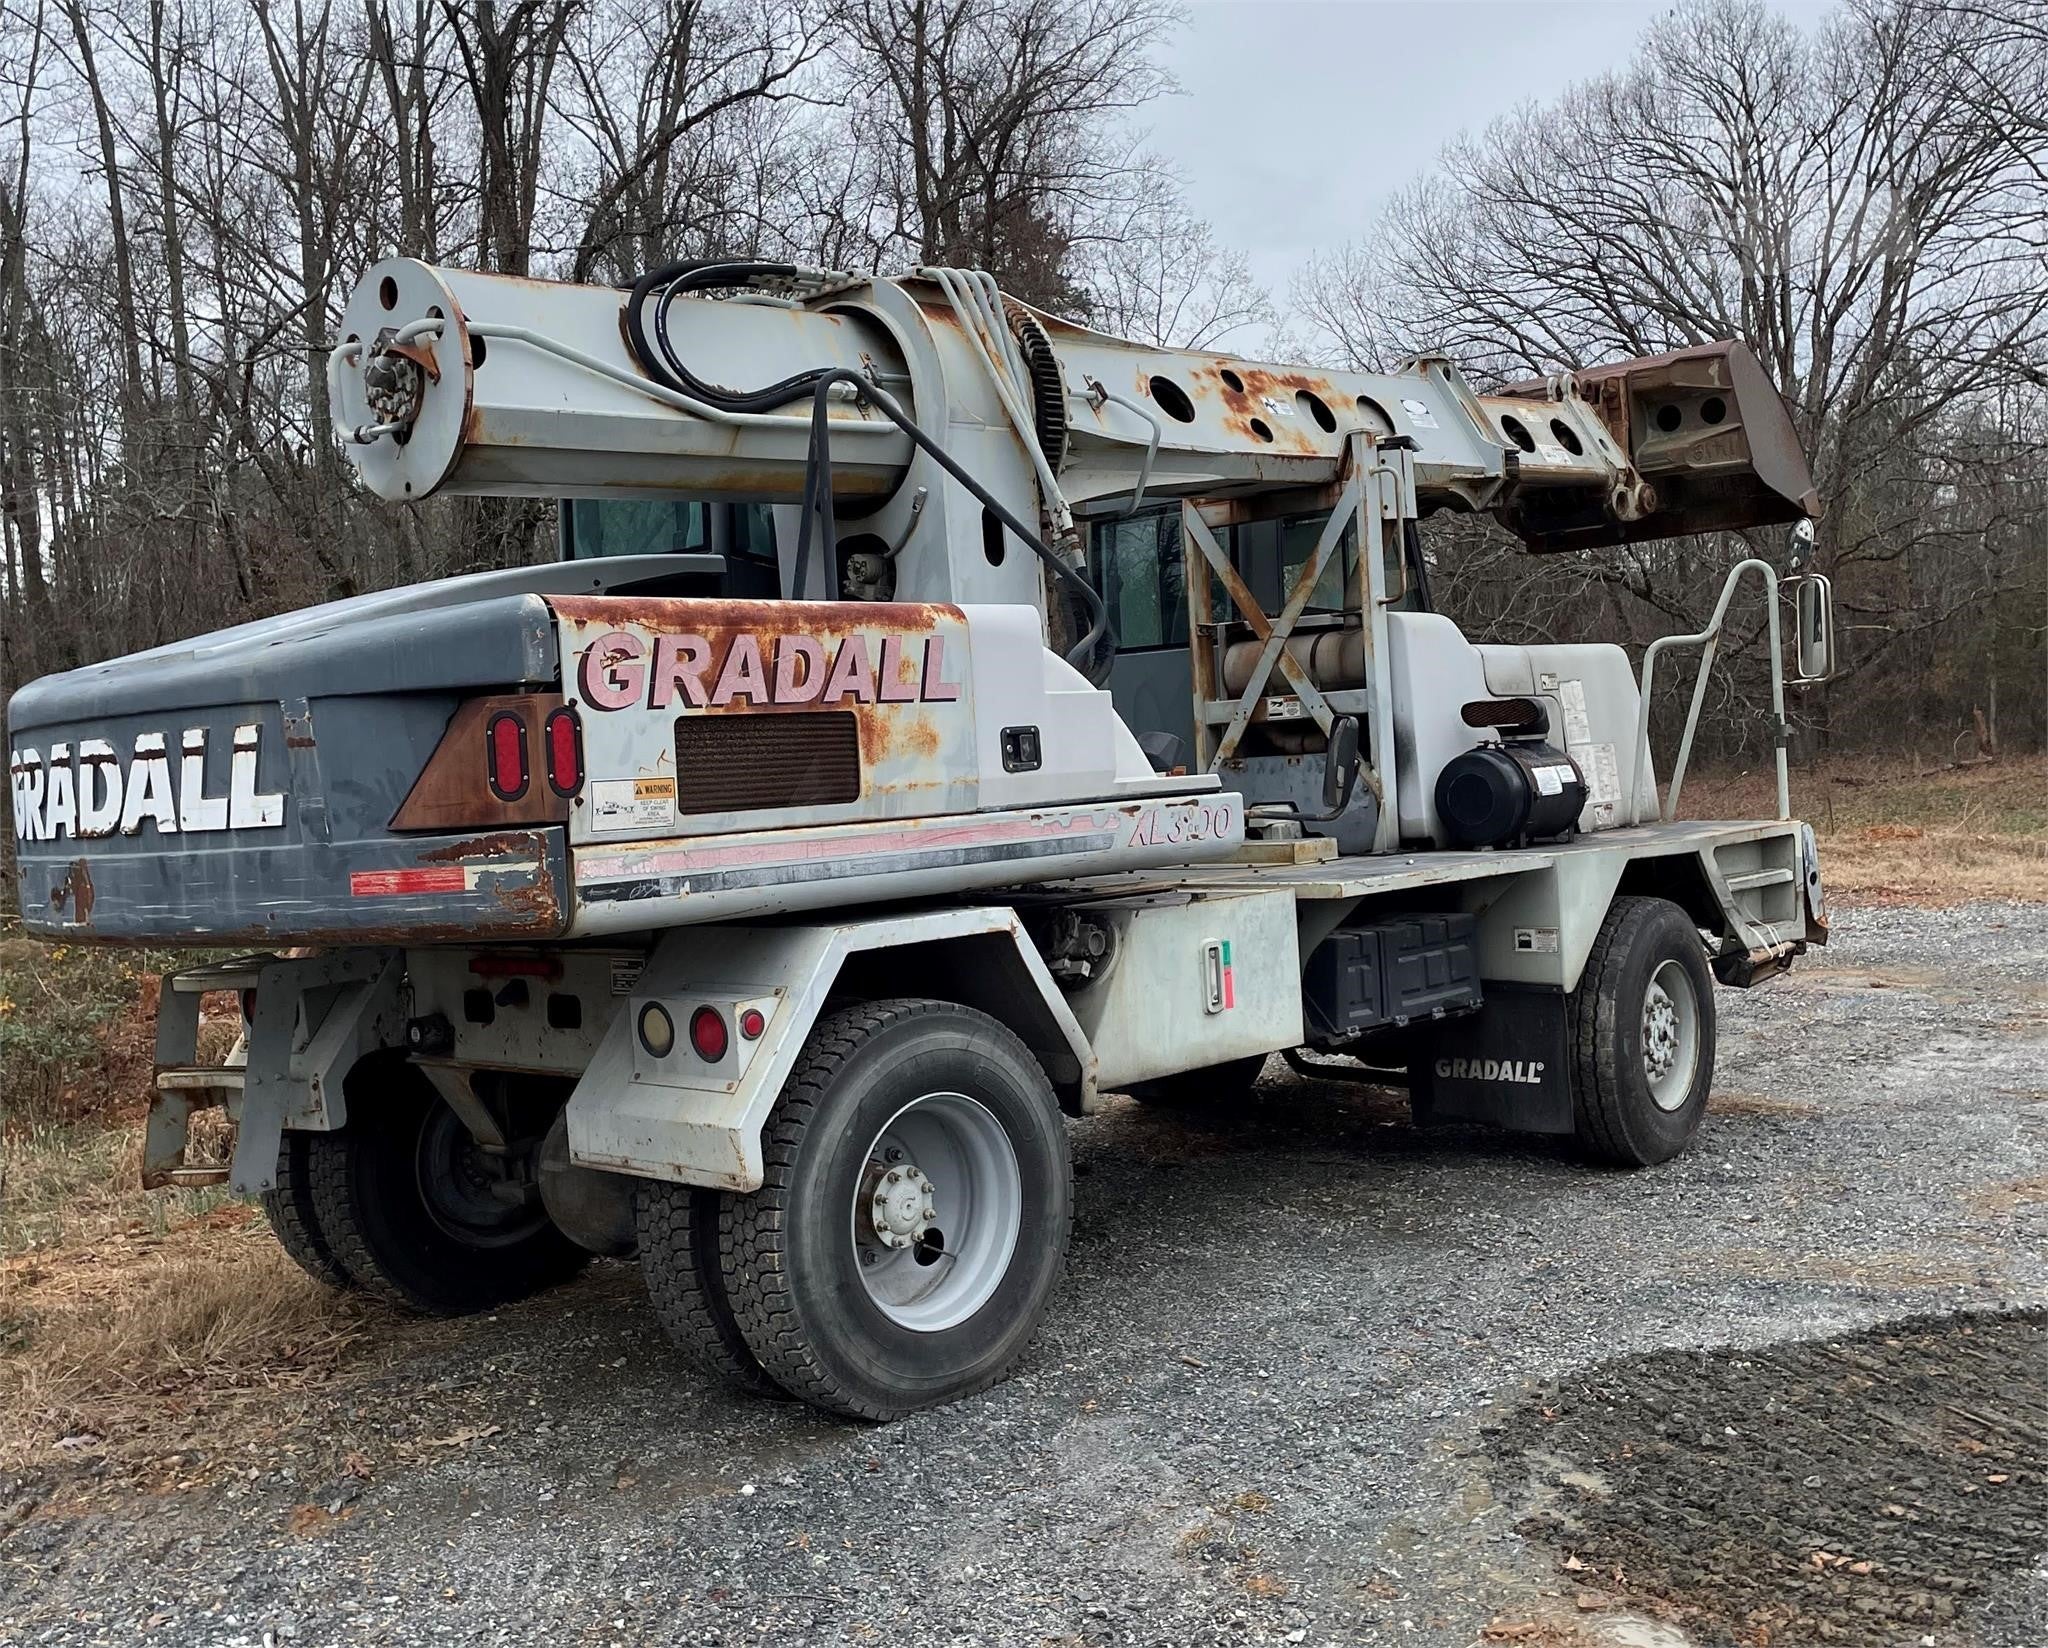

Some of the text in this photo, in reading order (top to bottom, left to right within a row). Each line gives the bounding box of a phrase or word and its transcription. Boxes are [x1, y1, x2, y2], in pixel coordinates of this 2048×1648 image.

[577, 632, 961, 711] GRADALL
[11, 724, 284, 840] GRADALL
[645, 784, 673, 795] WARNING
